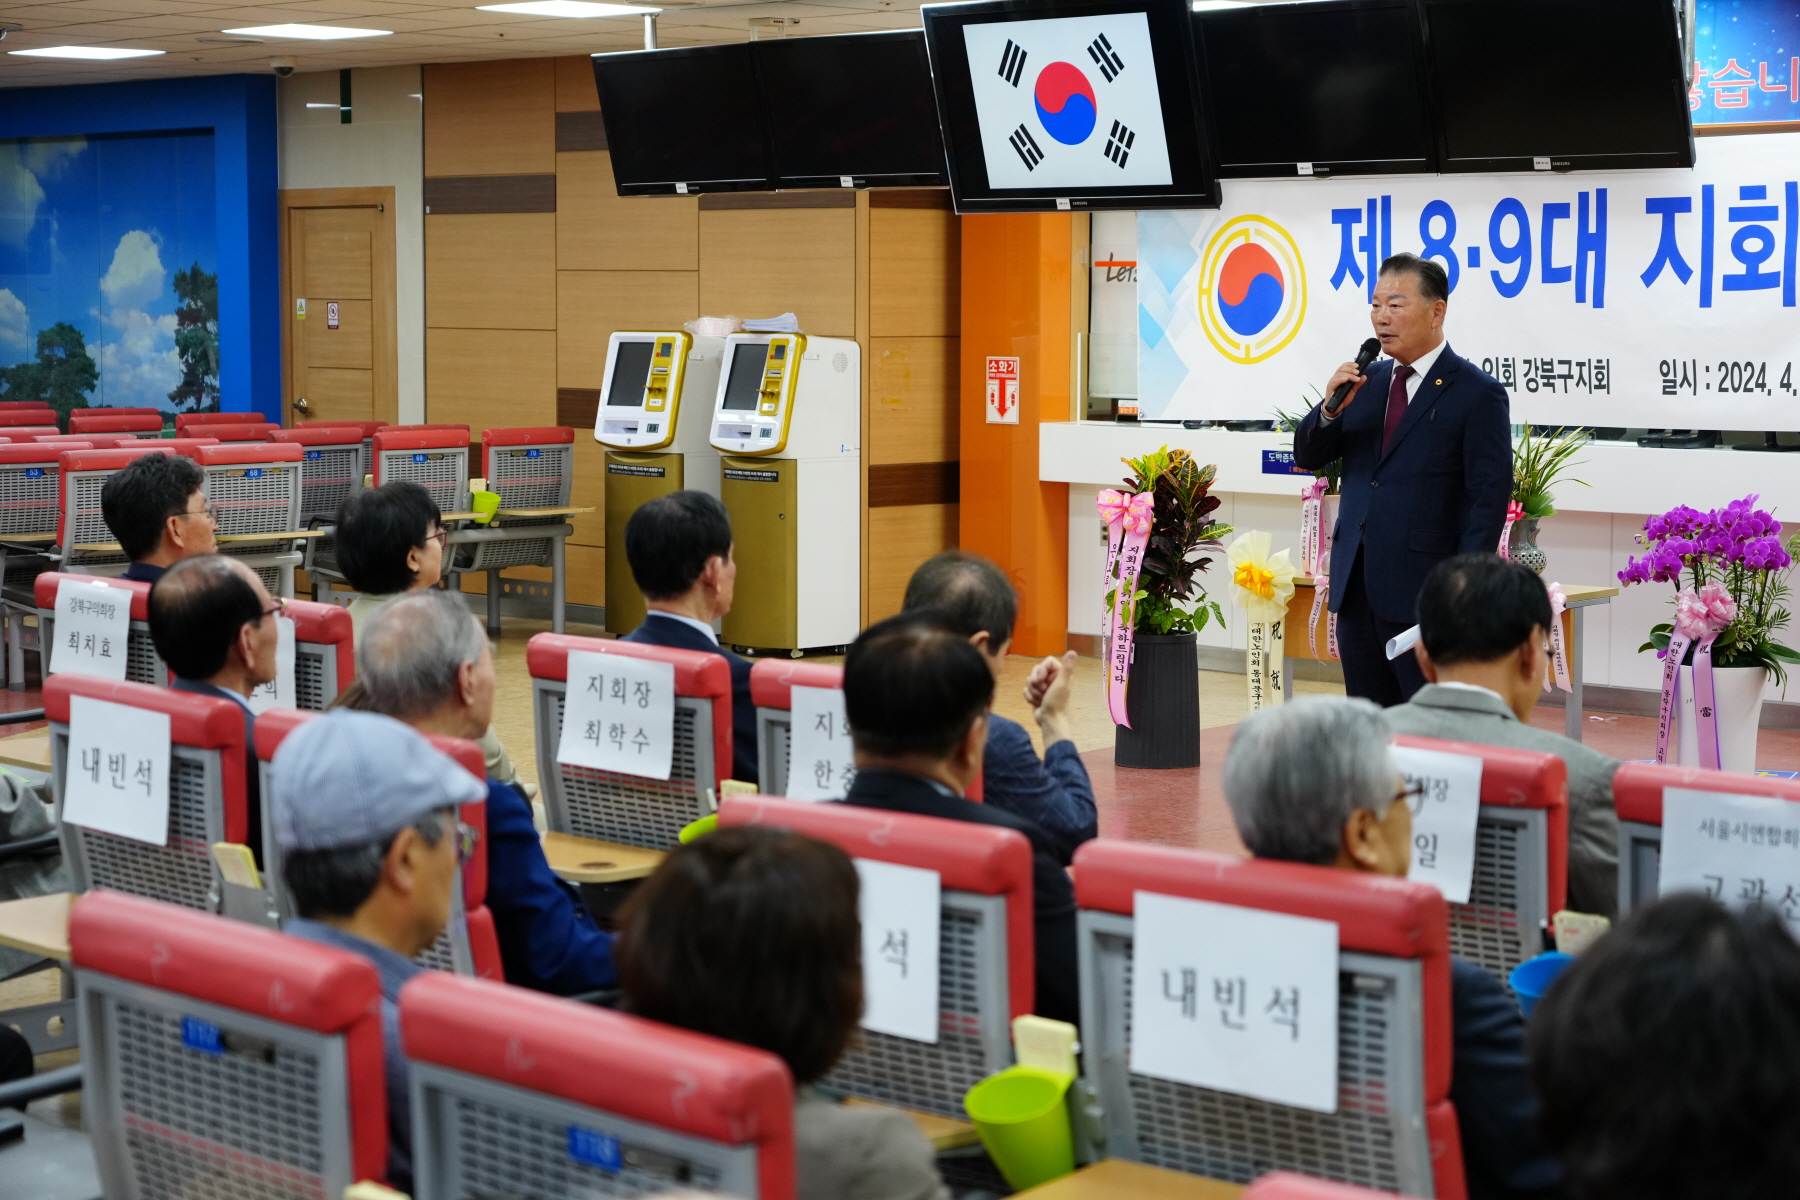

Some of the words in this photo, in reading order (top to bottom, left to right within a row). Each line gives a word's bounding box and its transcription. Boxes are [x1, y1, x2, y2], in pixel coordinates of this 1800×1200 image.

[1640, 181, 1799, 307] 지회
[989, 360, 1017, 374] 소화기
[1522, 357, 1611, 395] 강북구지회
[1659, 359, 1697, 396] 일시
[530, 449, 537, 457] 70
[29, 468, 39, 476] 53
[250, 469, 258, 477] 68
[68, 631, 112, 658] 최치효
[1250, 627, 1263, 667] 대한노인회
[1666, 641, 1683, 682] 대한노인회
[1699, 644, 1709, 655] 祝
[587, 674, 651, 709] 지회장
[584, 720, 650, 755] 최학수
[82, 747, 151, 797] 내빈석
[1162, 967, 1299, 1041] 내빈석
